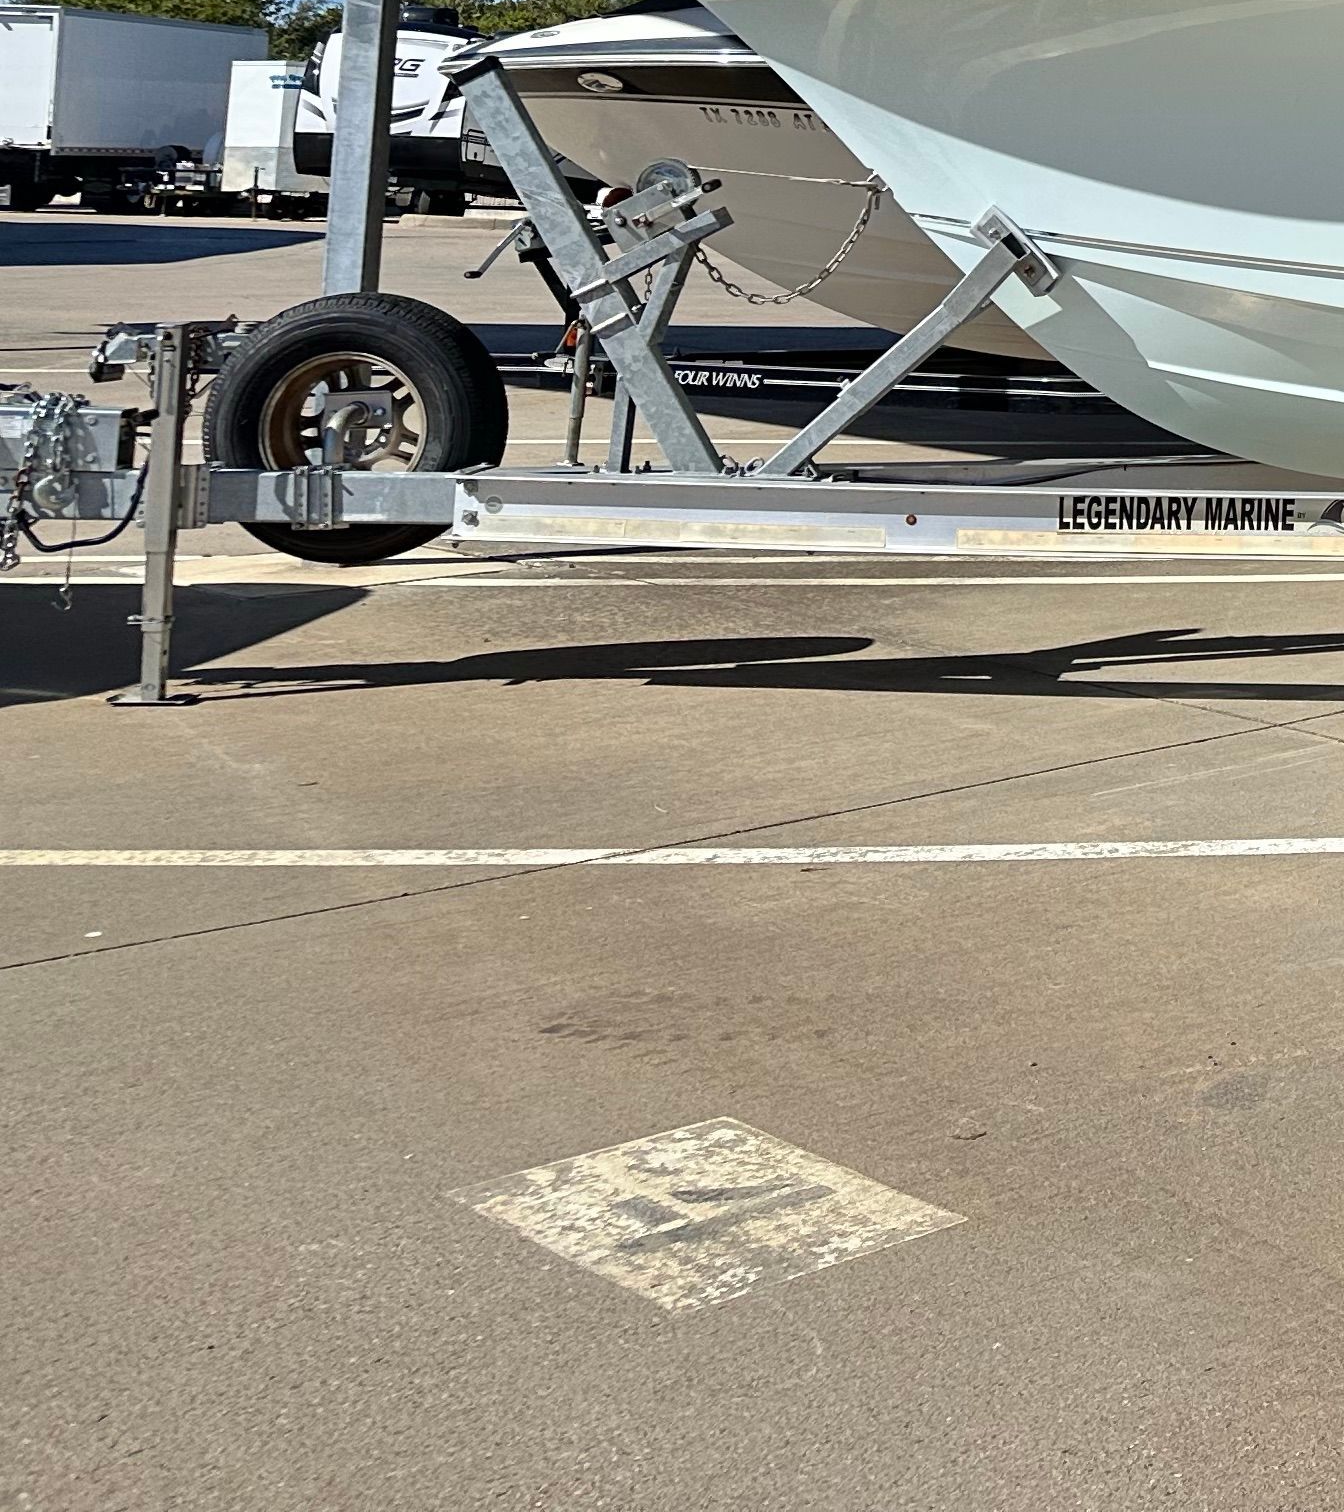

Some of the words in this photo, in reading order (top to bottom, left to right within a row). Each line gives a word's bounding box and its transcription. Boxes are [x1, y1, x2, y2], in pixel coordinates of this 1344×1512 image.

[699, 106, 727, 124] TX
[712, 371, 762, 389] WINNS
[1057, 495, 1199, 532] LEGENDARY
[1203, 497, 1296, 531] MARINE
